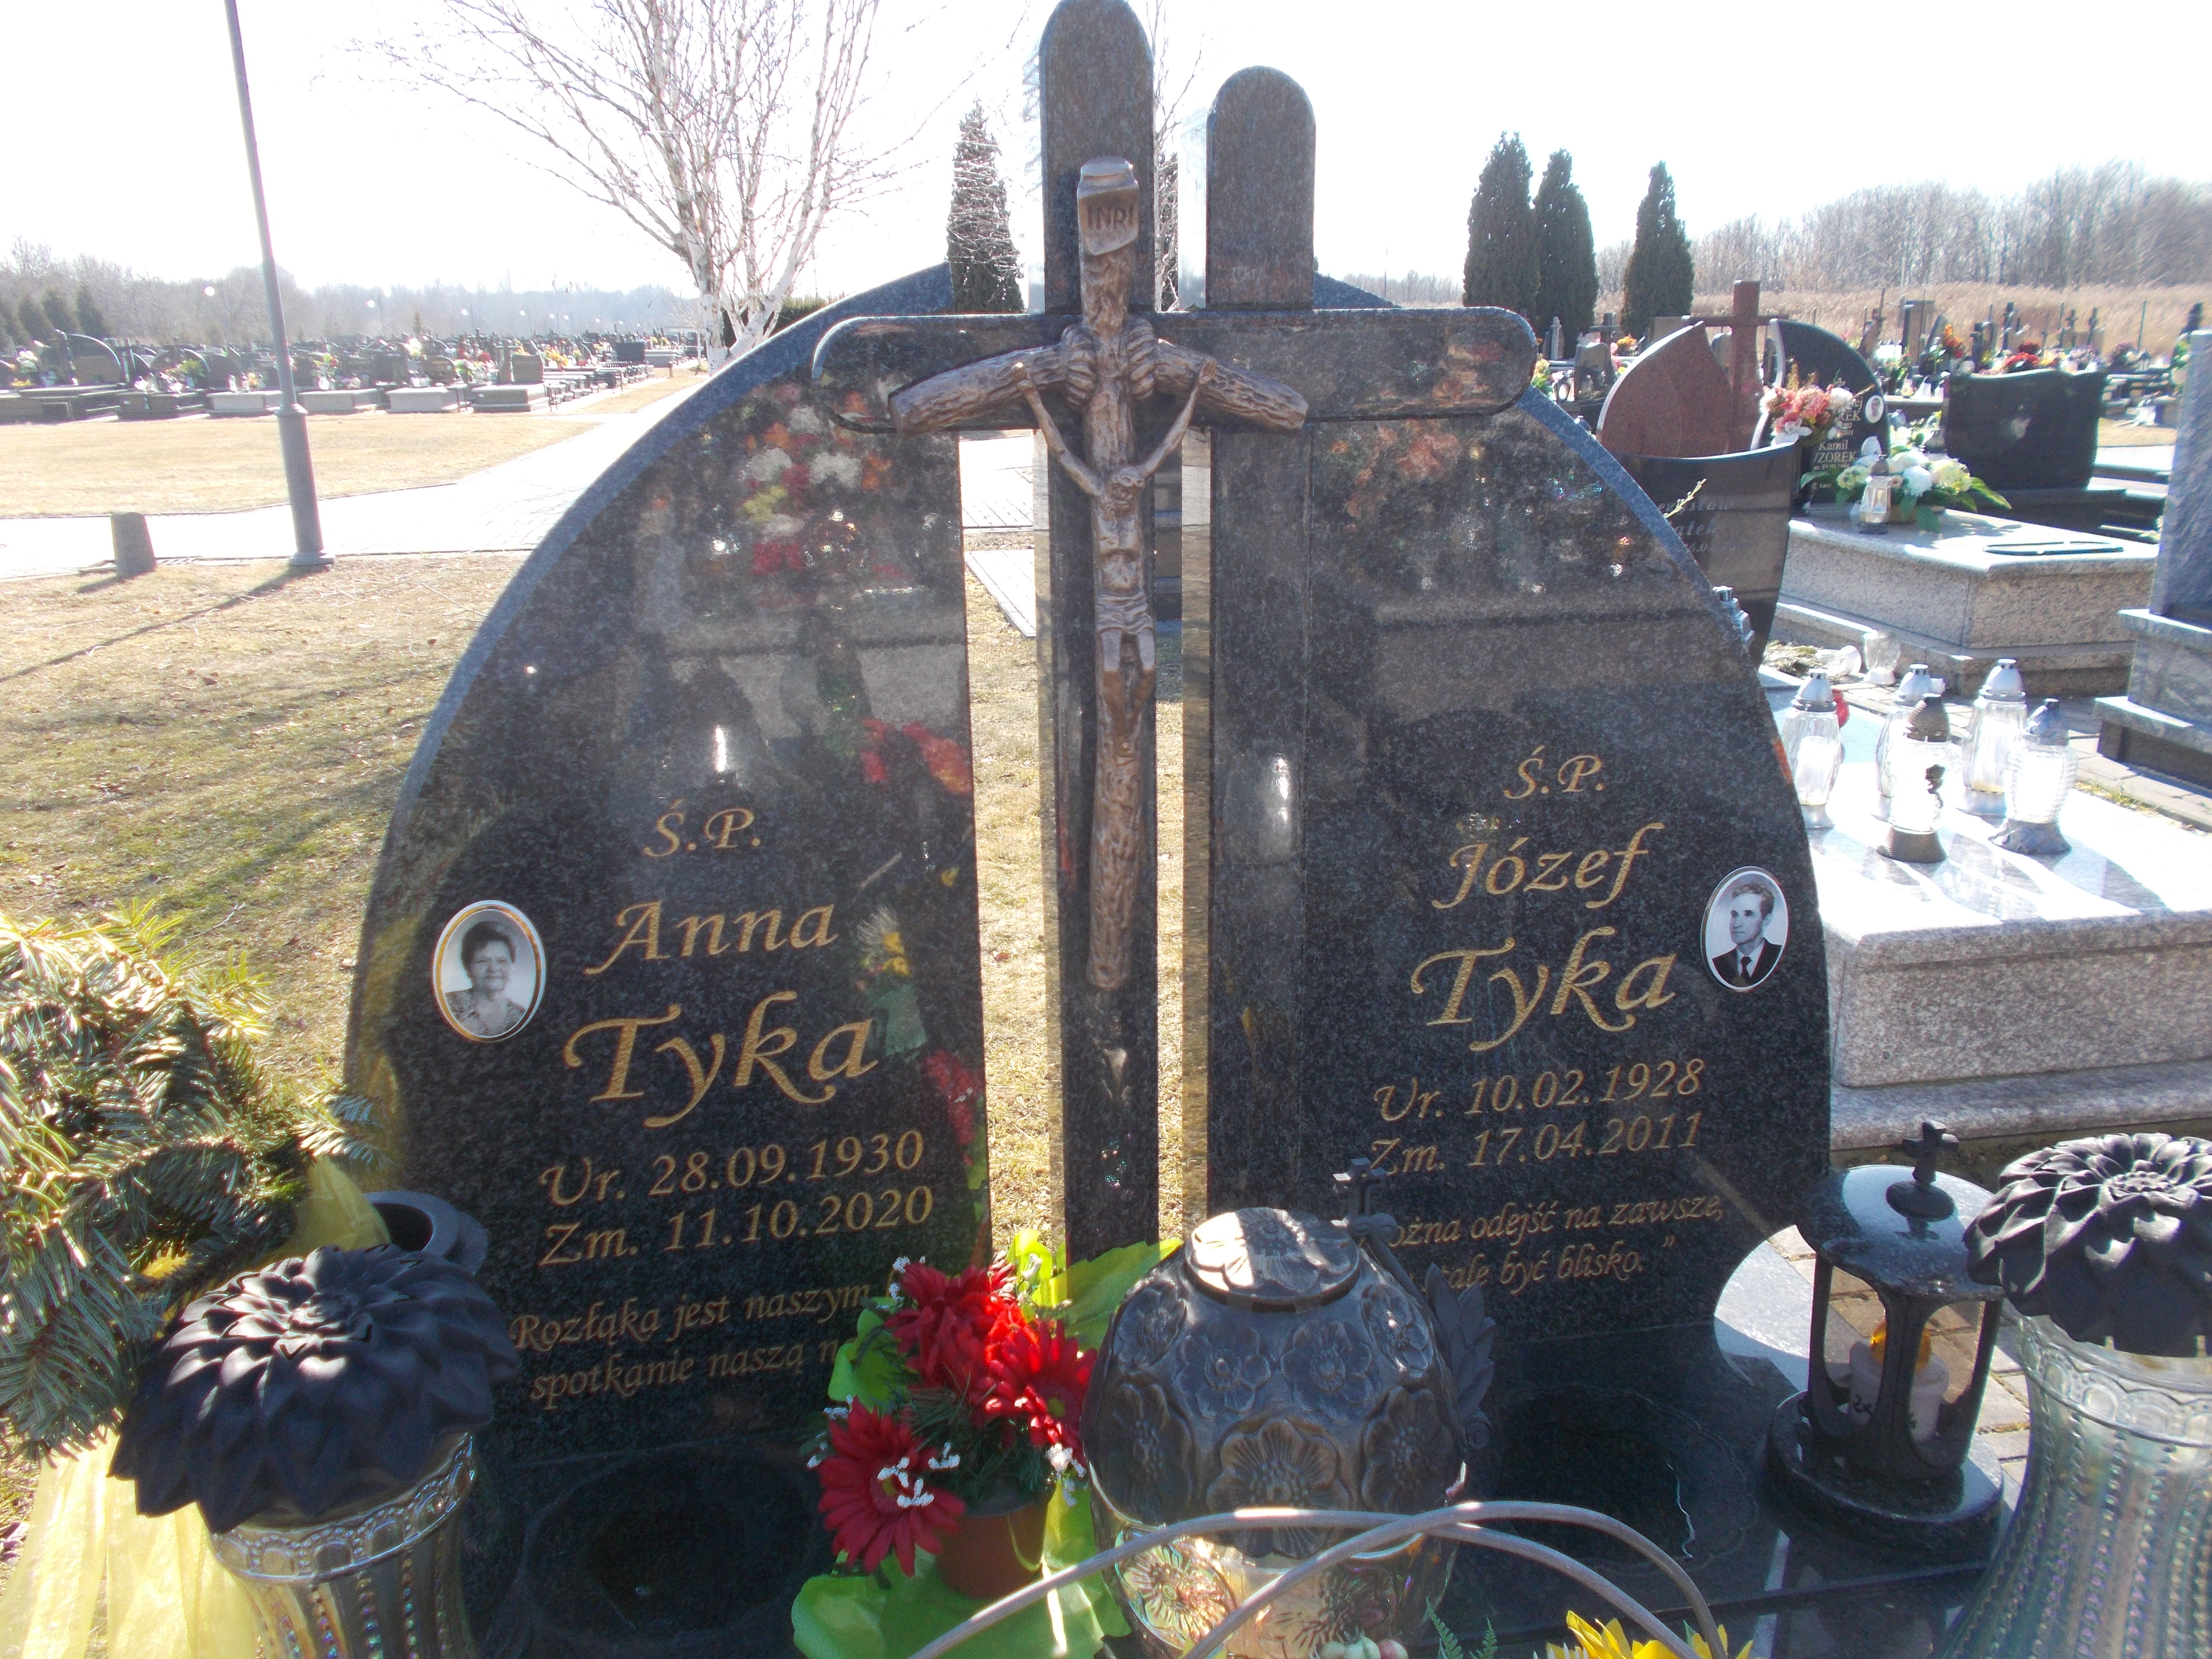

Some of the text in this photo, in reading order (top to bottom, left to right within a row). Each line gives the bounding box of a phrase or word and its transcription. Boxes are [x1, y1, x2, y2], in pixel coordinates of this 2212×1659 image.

[1087, 204, 1134, 232] INRI
[1818, 439, 1849, 450] Kamil
[1432, 822, 1665, 910] Józef
[584, 900, 838, 975] Anna
[1410, 926, 1678, 1051] Tyka
[563, 990, 878, 1128] Tyka
[1373, 1058, 1705, 1122] Ur. 10.02.1928
[538, 1130, 924, 1205] Ur. 28.09.1930
[1371, 1110, 1703, 1177] Zm. 17.04.2011
[538, 1186, 934, 1268] Zm. 11.10.2020
[1388, 1195, 1724, 1248] ożna odejść na zawsze,
[1499, 1249, 1551, 1296] być
[510, 1284, 870, 1351] Rozłąka jest naszym
[529, 1346, 693, 1411] spotkanie
[708, 1344, 805, 1375] naszą
